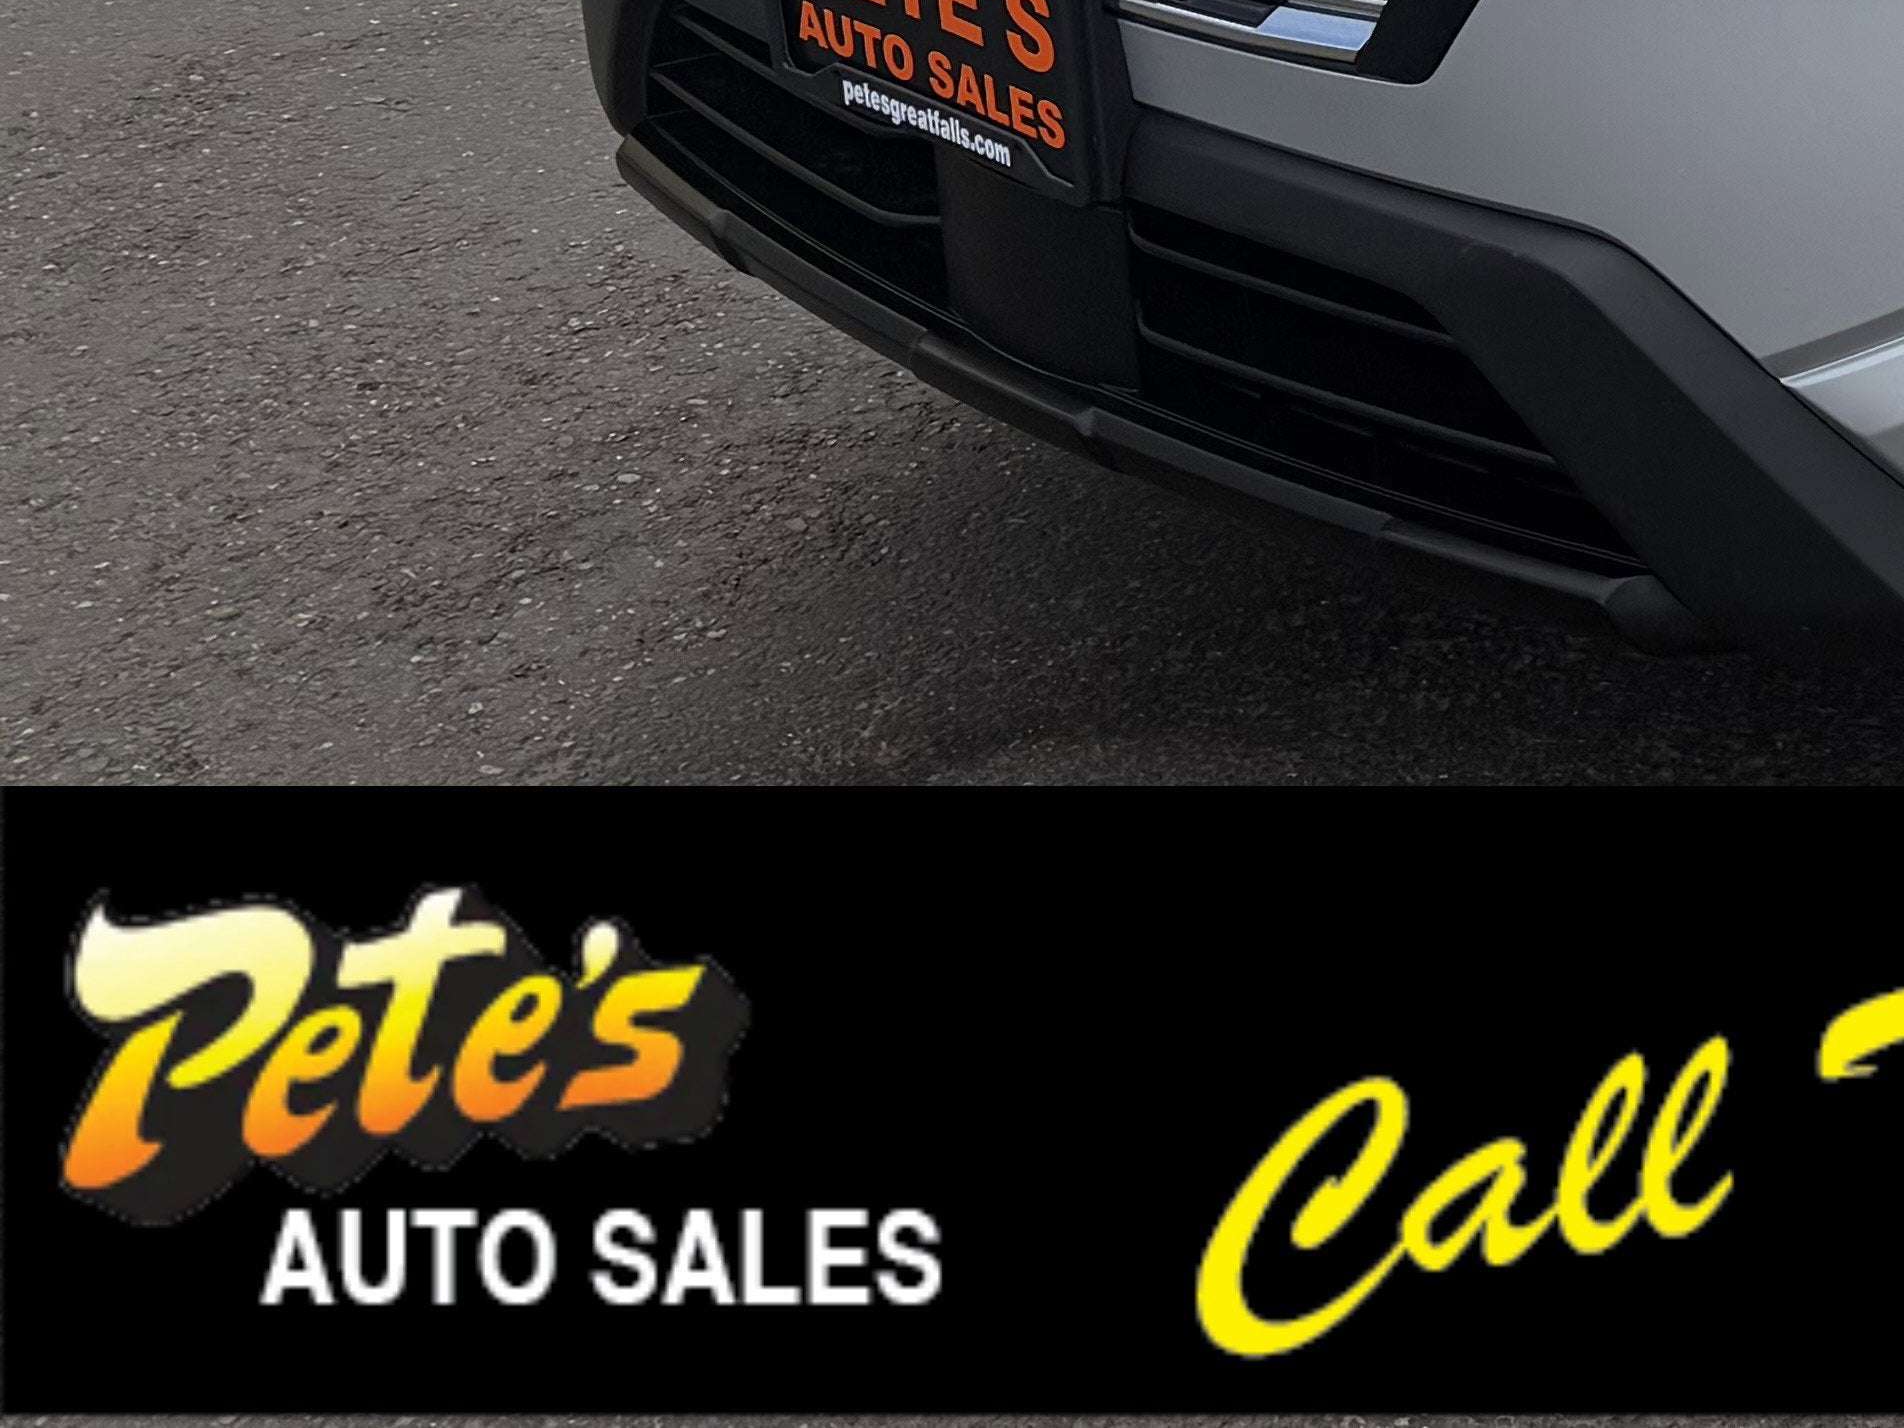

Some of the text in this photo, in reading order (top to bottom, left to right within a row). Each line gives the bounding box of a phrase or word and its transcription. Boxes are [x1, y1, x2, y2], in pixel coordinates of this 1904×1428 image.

[799, 0, 1066, 149] AUTO SALES
[842, 79, 1011, 168] petesgreatfalls.com
